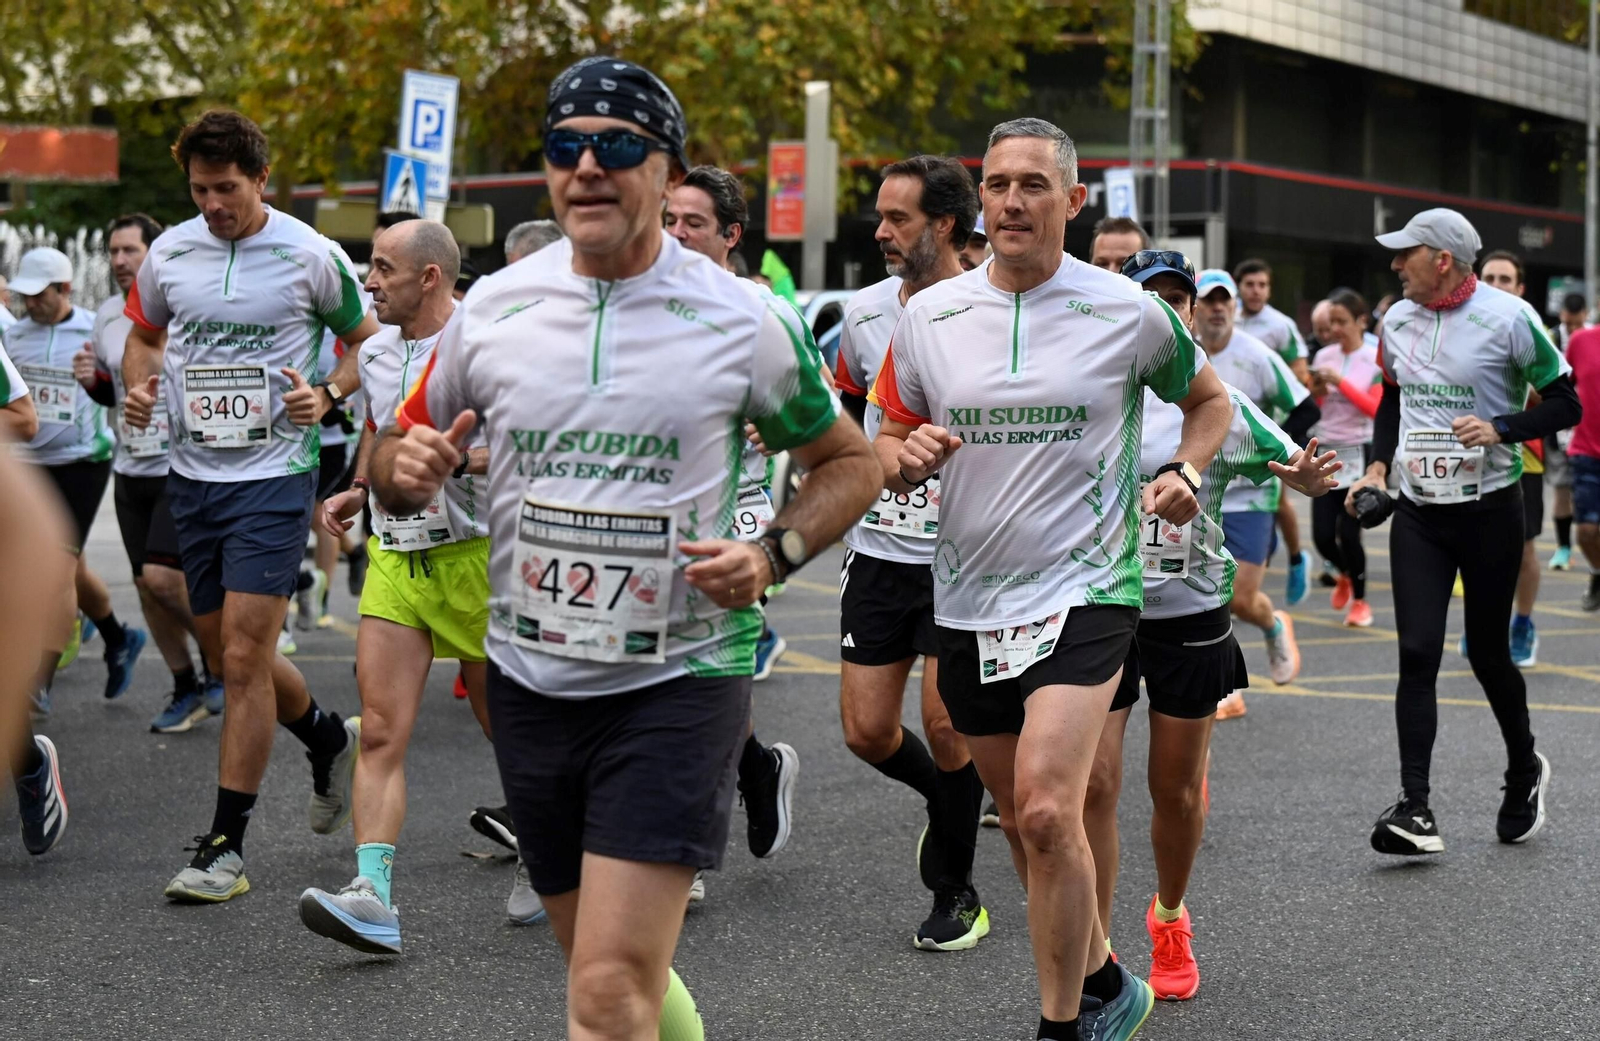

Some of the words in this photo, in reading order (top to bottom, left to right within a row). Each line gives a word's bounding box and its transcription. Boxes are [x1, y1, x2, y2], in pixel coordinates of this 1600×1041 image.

[414, 103, 440, 147] P
[664, 297, 698, 321] SIG
[1066, 300, 1093, 315] SIG
[1093, 311, 1119, 324] Laboral
[1467, 313, 1482, 326] SIG
[207, 321, 276, 336] SUBIDA
[195, 337, 215, 346] LAS
[218, 338, 274, 350] ERMITAS
[215, 370, 221, 378] A
[221, 370, 232, 378] LAS
[233, 369, 260, 377] ERMITAS
[29, 386, 60, 405] 161
[1418, 384, 1475, 398] SUBIDA
[200, 395, 248, 420] 340
[948, 408, 982, 426] XII
[989, 405, 1088, 425] SUBIDA
[1426, 399, 1475, 410] ERMITAS
[508, 430, 550, 453] XII
[555, 430, 681, 461] SUBIDA
[958, 431, 967, 444] A
[970, 431, 1003, 444] LAS
[1006, 428, 1083, 444] ERMITAS
[529, 461, 569, 478] LAS
[573, 462, 674, 485] ERMITAS
[1418, 456, 1464, 479] 167
[534, 507, 575, 526] SUBIDA
[575, 514, 585, 527] A
[586, 515, 609, 530] LAS
[610, 516, 663, 533] ERMITAS
[537, 558, 634, 611] 427
